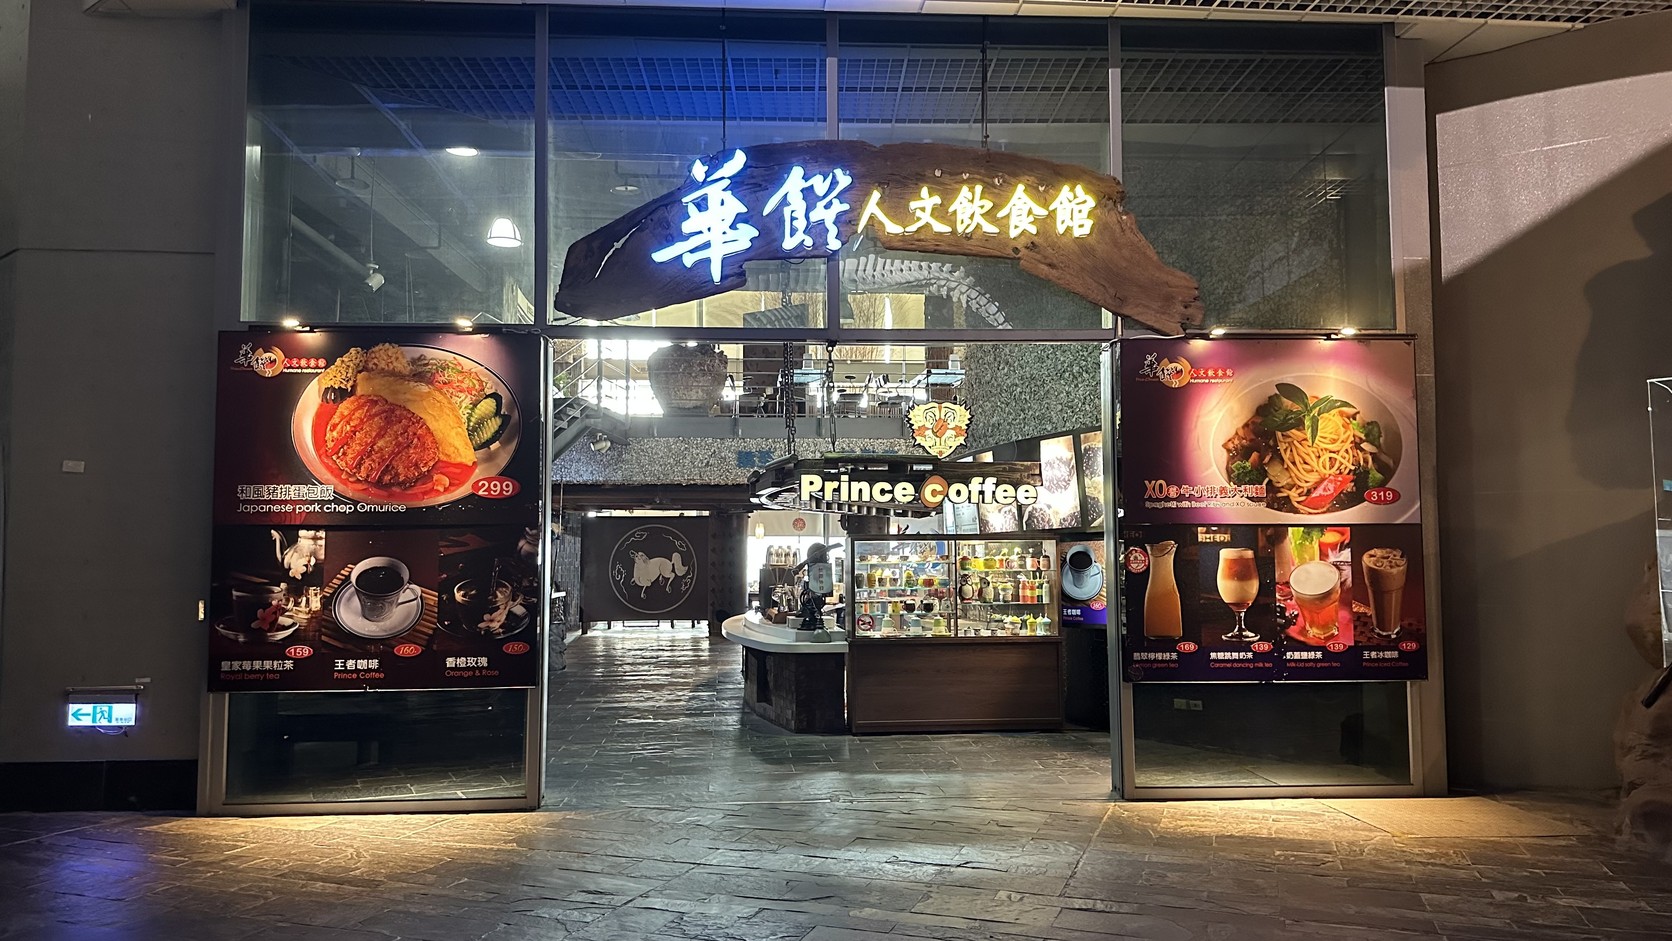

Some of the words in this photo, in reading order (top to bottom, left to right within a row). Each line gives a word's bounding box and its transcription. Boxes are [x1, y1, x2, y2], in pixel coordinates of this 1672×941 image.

[857, 183, 1097, 239] 人文飲食館
[236, 484, 335, 501] 和風豬排蛋包飯
[478, 480, 513, 496] 299
[800, 474, 915, 503] Prince
[1370, 490, 1394, 501] 319
[237, 502, 294, 514] Japanese
[295, 502, 322, 514] pork
[323, 502, 355, 514] chop
[356, 502, 407, 513] Omurice
[1180, 643, 1195, 651] 169
[1254, 643, 1269, 651] 139
[1329, 642, 1344, 650] 139
[1402, 641, 1417, 650] 129
[289, 648, 310, 657] 159
[333, 659, 380, 670] 王者咖啡
[445, 656, 489, 668] 香橙玫瑰
[266, 671, 280, 680] tea
[333, 671, 357, 679] Prince
[359, 671, 385, 679] Coffee
[445, 669, 473, 678] Orange
